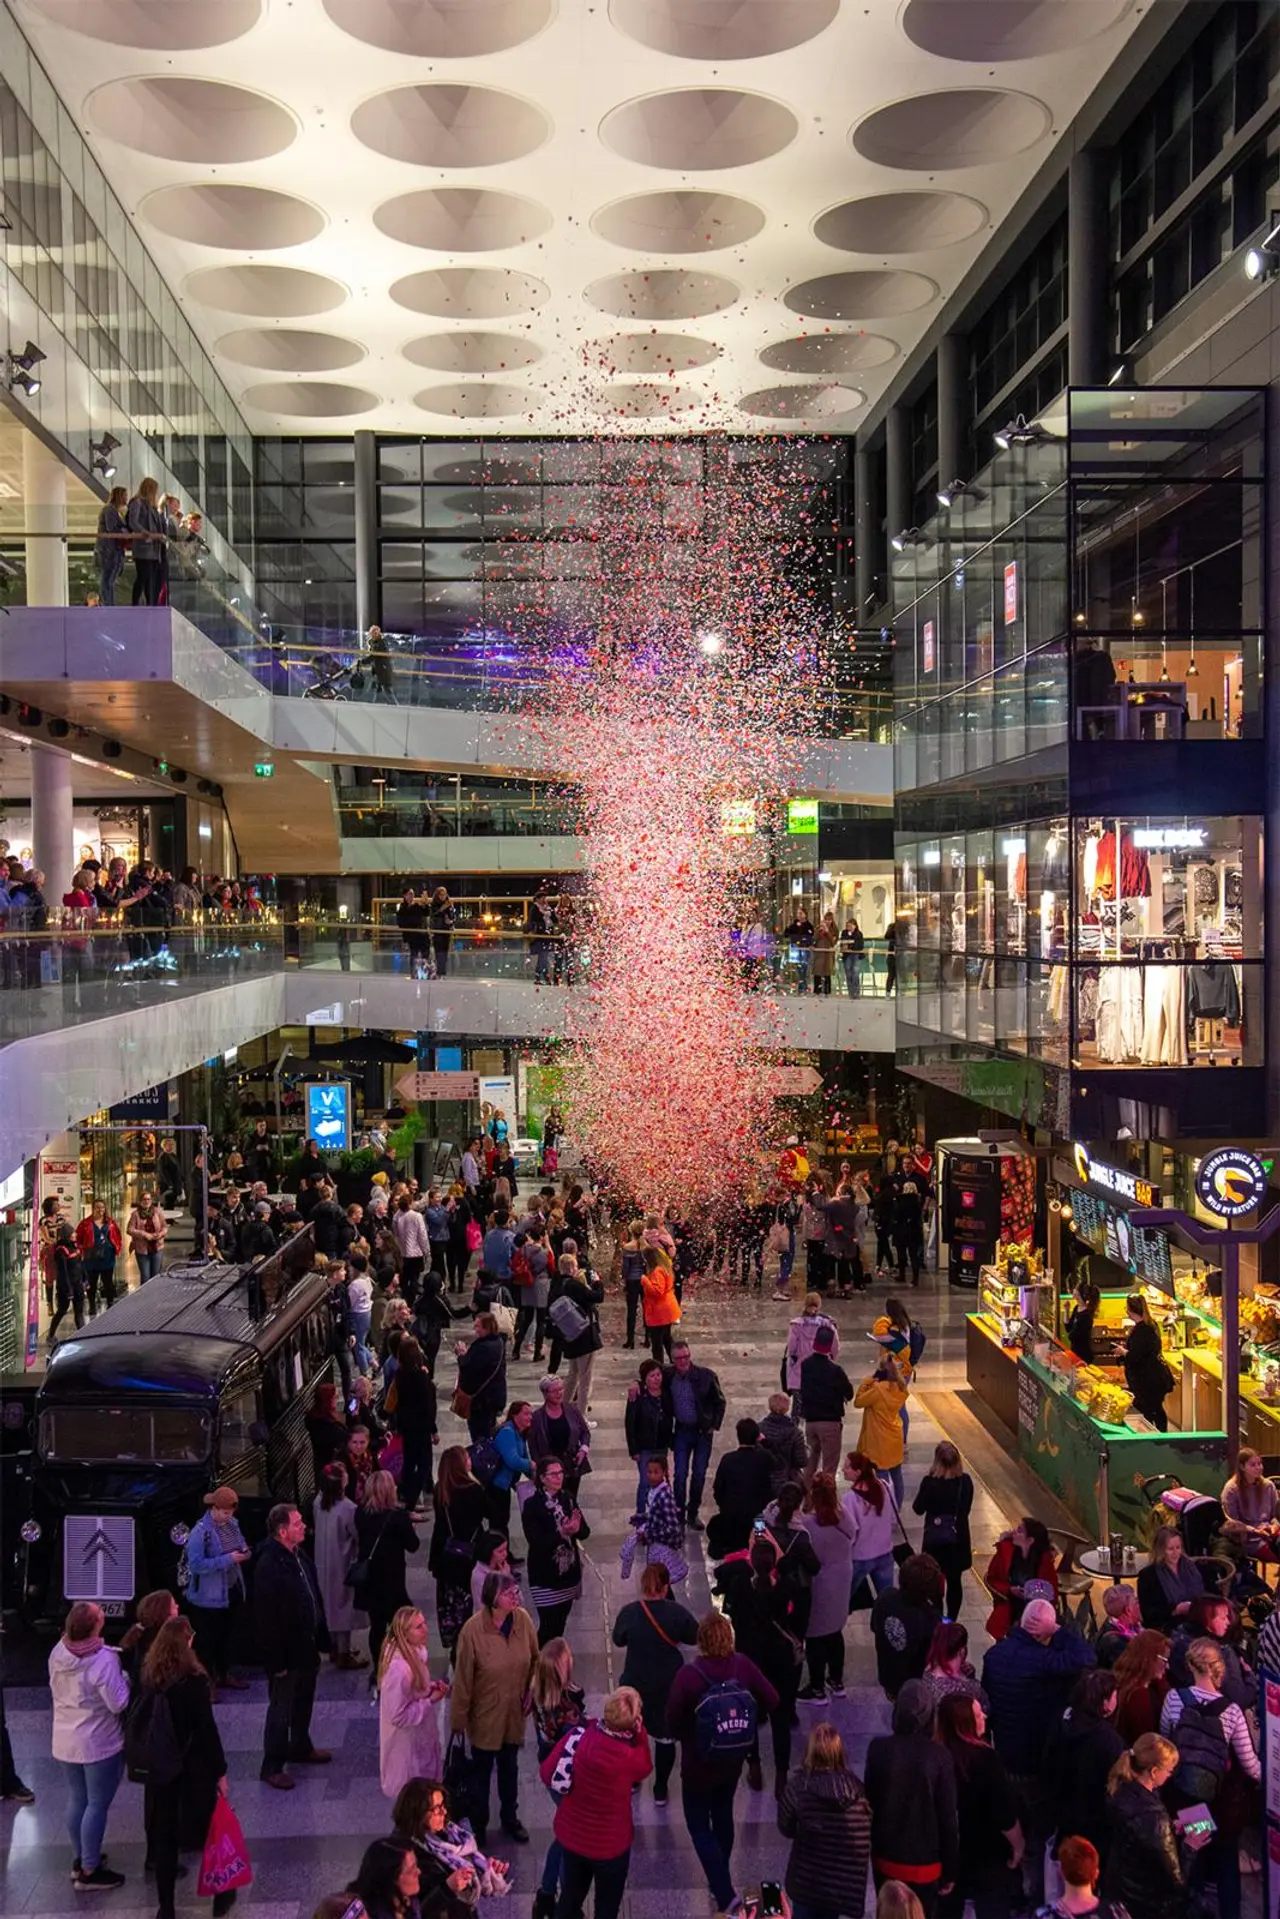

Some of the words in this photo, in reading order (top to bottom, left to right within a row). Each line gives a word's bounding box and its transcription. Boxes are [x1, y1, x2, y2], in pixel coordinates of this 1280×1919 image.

[1229, 1152, 1251, 1165] JUICE
[1249, 1161, 1262, 1178] BAR
[1114, 1172, 1136, 1200] JUICE
[1135, 1180, 1152, 1207] BAR
[1206, 1194, 1222, 1211] WILD
[1221, 1206, 1232, 1214] BY
[1232, 1195, 1258, 1214] NATURE
[716, 1719, 749, 1733] SWEDEN
